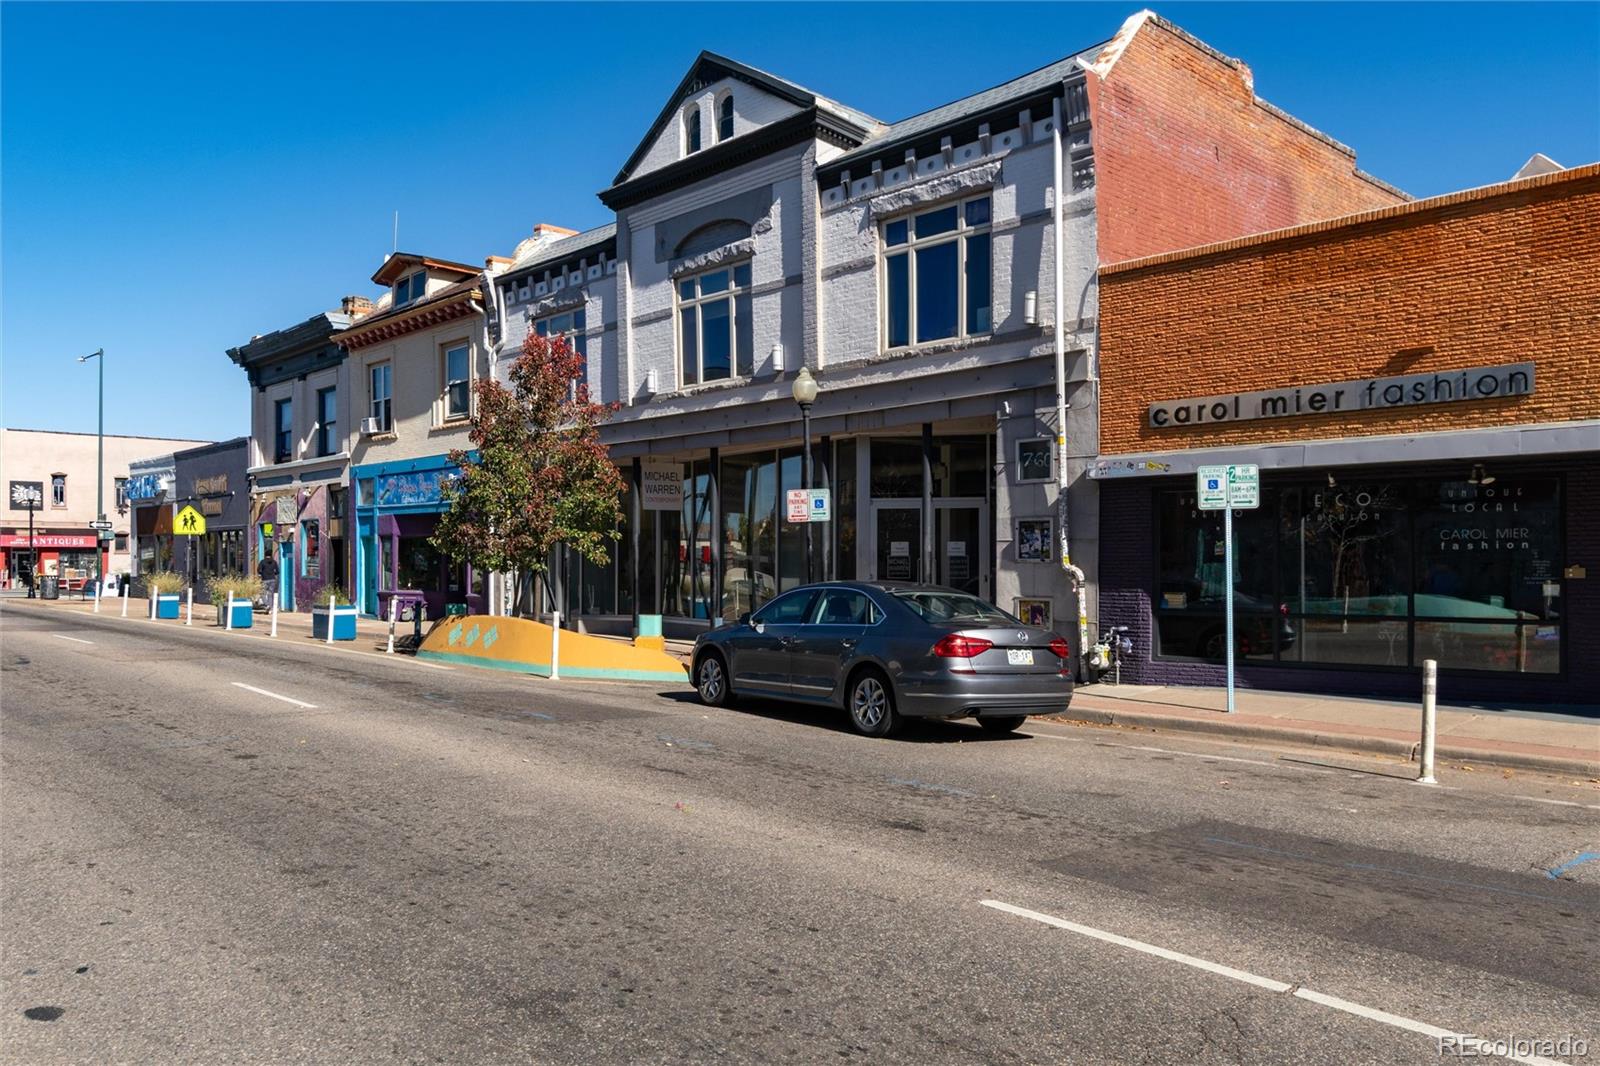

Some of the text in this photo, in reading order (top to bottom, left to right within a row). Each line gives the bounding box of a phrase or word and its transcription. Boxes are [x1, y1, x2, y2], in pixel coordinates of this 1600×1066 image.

[1152, 371, 1528, 426] carol mier fashion
[644, 471, 680, 482] MICHAEL
[645, 484, 681, 495] WARREN
[1314, 492, 1371, 508] ECO
[1452, 502, 1519, 512] LOCAL
[1191, 509, 1243, 518] RETO
[1440, 527, 1529, 540] CAROL MIER
[1440, 541, 1529, 550] fashion
